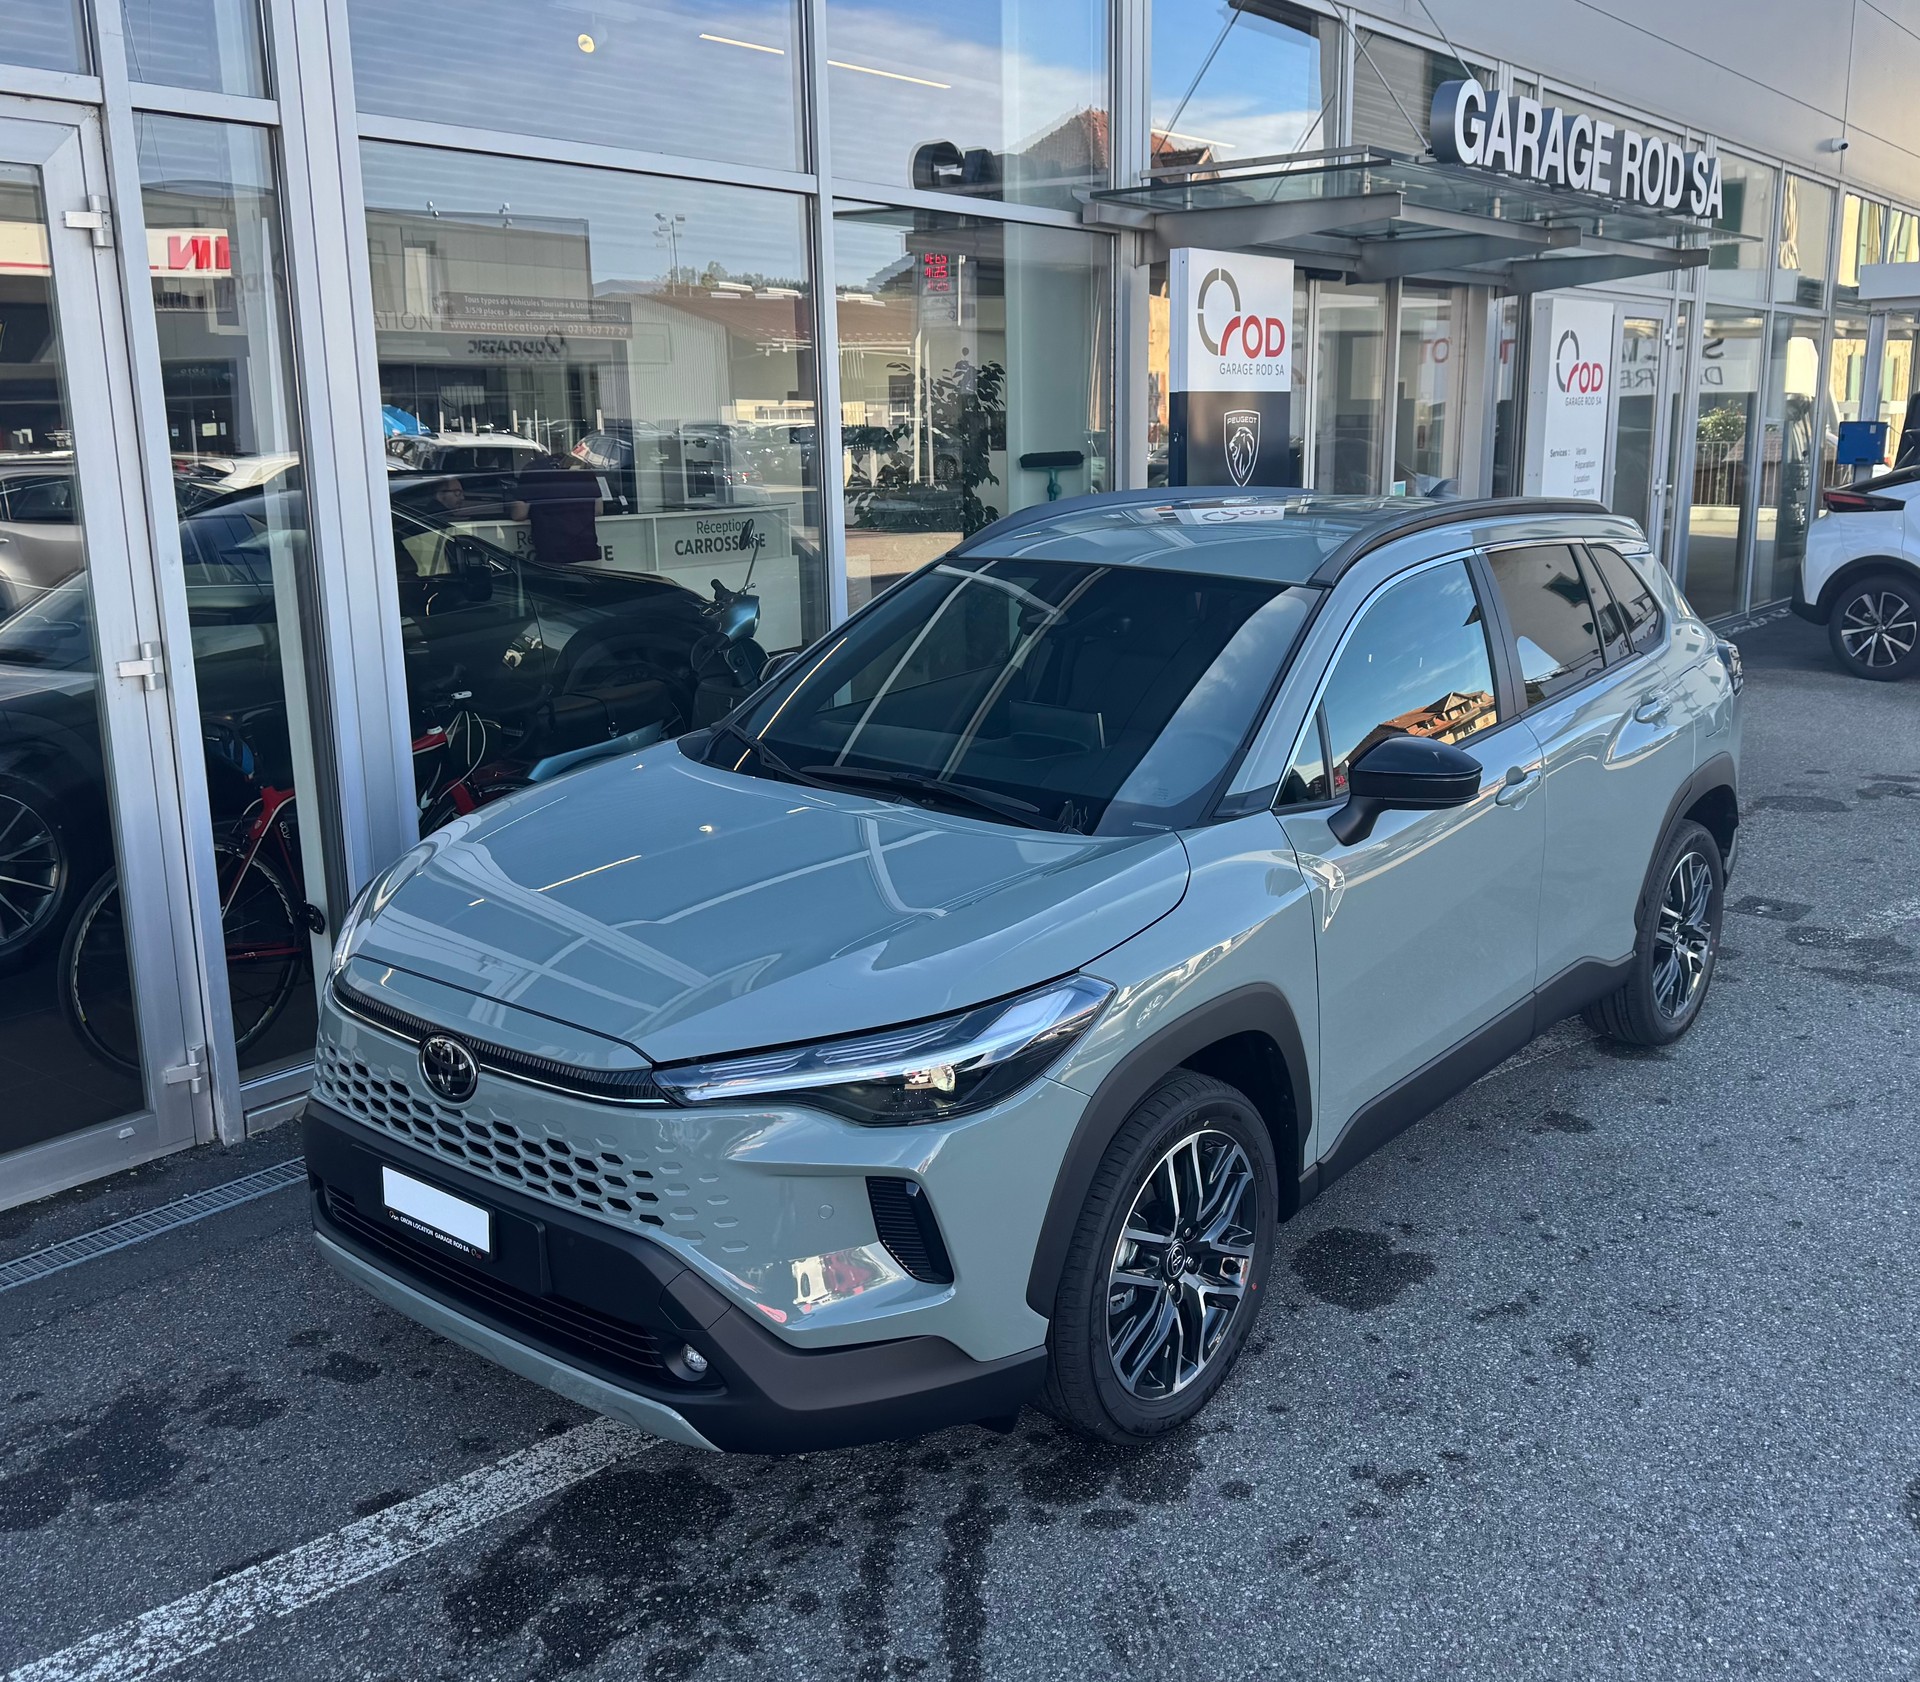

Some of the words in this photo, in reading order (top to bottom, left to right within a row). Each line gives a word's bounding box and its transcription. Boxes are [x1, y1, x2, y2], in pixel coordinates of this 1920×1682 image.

[1455, 79, 1615, 195] GARAGE
[1620, 129, 1685, 209] ROD
[1690, 150, 1723, 220] SA
[500, 297, 508, 305] de
[568, 325, 583, 334] 021
[587, 326, 602, 335] 907
[605, 327, 615, 336] 77
[1220, 362, 1253, 376] GARAGE
[1256, 363, 1273, 376] ROD
[1275, 363, 1285, 376] SA
[1565, 396, 1584, 406] GARAGE
[1585, 396, 1595, 406] ROD
[1596, 396, 1602, 406] SA
[1226, 415, 1258, 425] PEUGEOT
